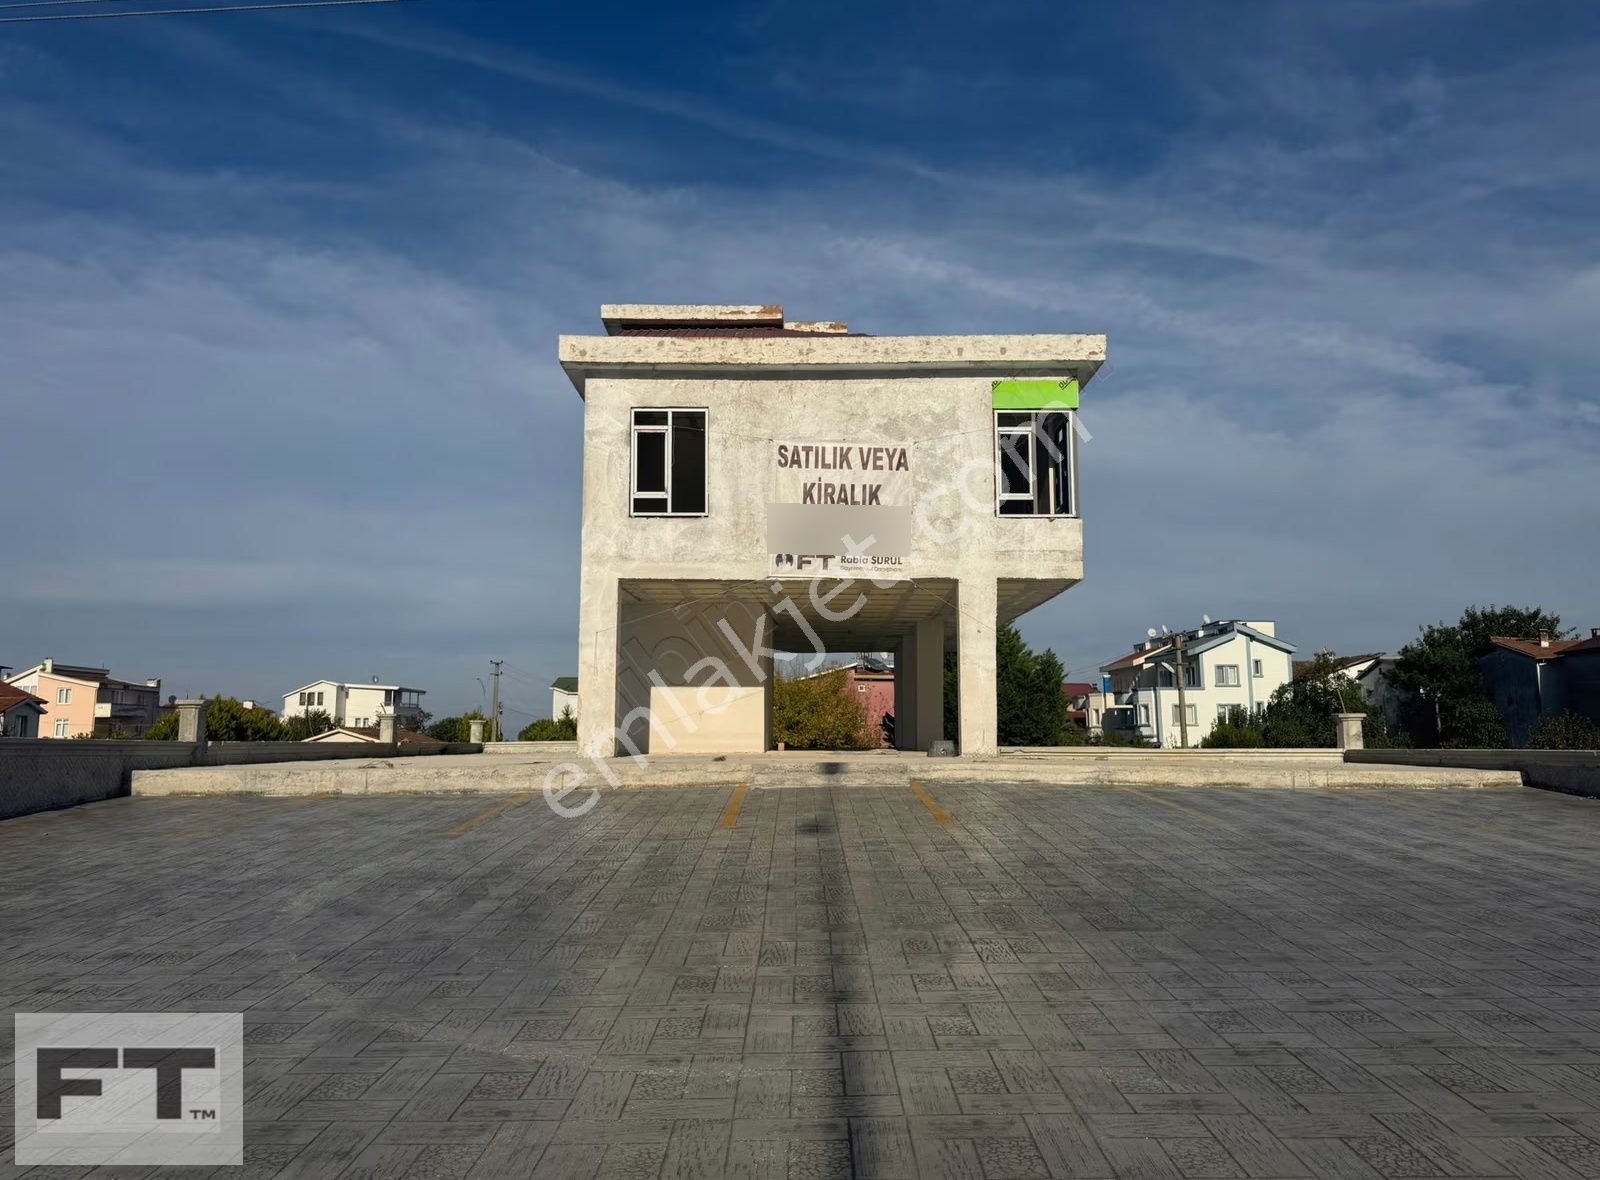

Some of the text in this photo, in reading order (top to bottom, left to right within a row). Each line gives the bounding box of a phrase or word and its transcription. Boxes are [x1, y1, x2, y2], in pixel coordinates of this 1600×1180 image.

[777, 444, 909, 471] SATILIK VEYA
[802, 476, 882, 506] KİRALIK
[796, 554, 836, 570] FT
[840, 555, 903, 565] Rabia SURUL
